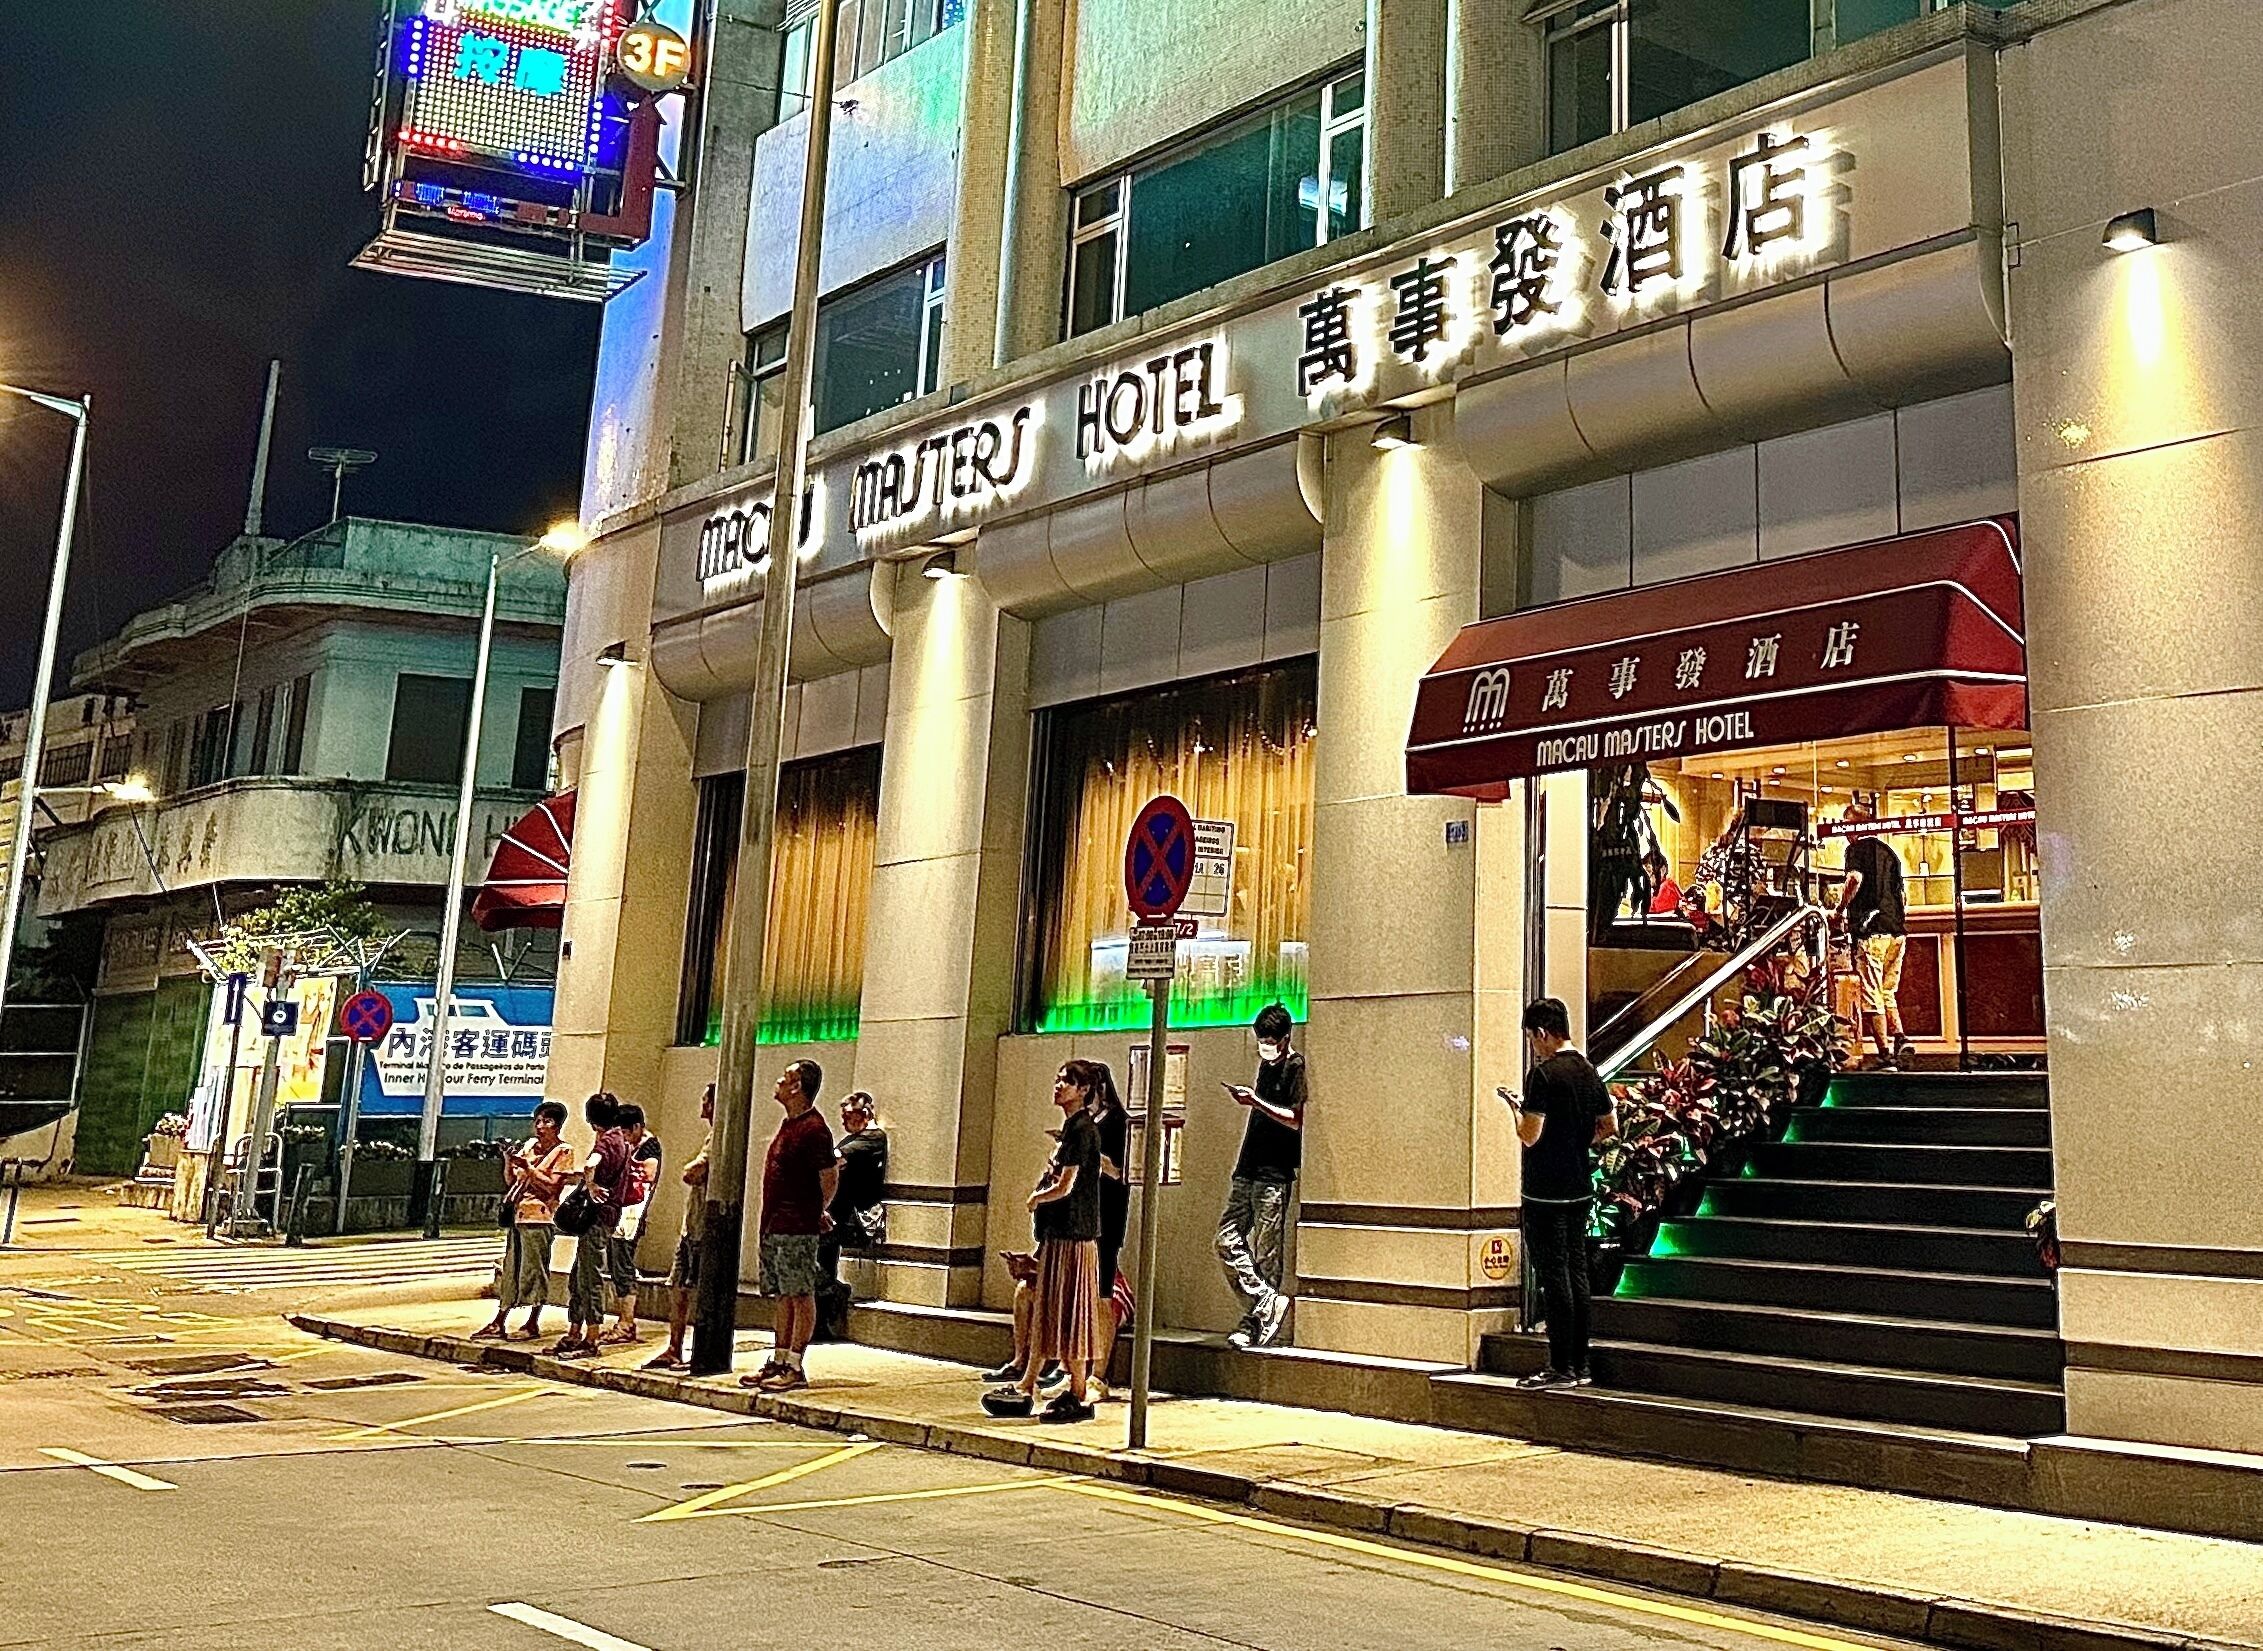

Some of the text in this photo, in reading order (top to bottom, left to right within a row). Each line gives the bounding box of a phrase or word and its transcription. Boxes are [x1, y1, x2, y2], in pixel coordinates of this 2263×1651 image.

[624, 33, 686, 76] 3F
[1298, 133, 1810, 397] 萬事發酒店
[696, 342, 1224, 581] MACU MASTERS HOTEL
[1541, 621, 1861, 712] 萬事發酒店
[1536, 711, 1754, 767] MACAU MASTERS HOTEL
[379, 1061, 414, 1070] Terminal
[452, 1061, 463, 1070] de
[466, 1062, 512, 1072] Passageiros
[526, 1063, 545, 1071] Porto
[384, 1072, 545, 1087] Inner Hour Ferry Terminal
